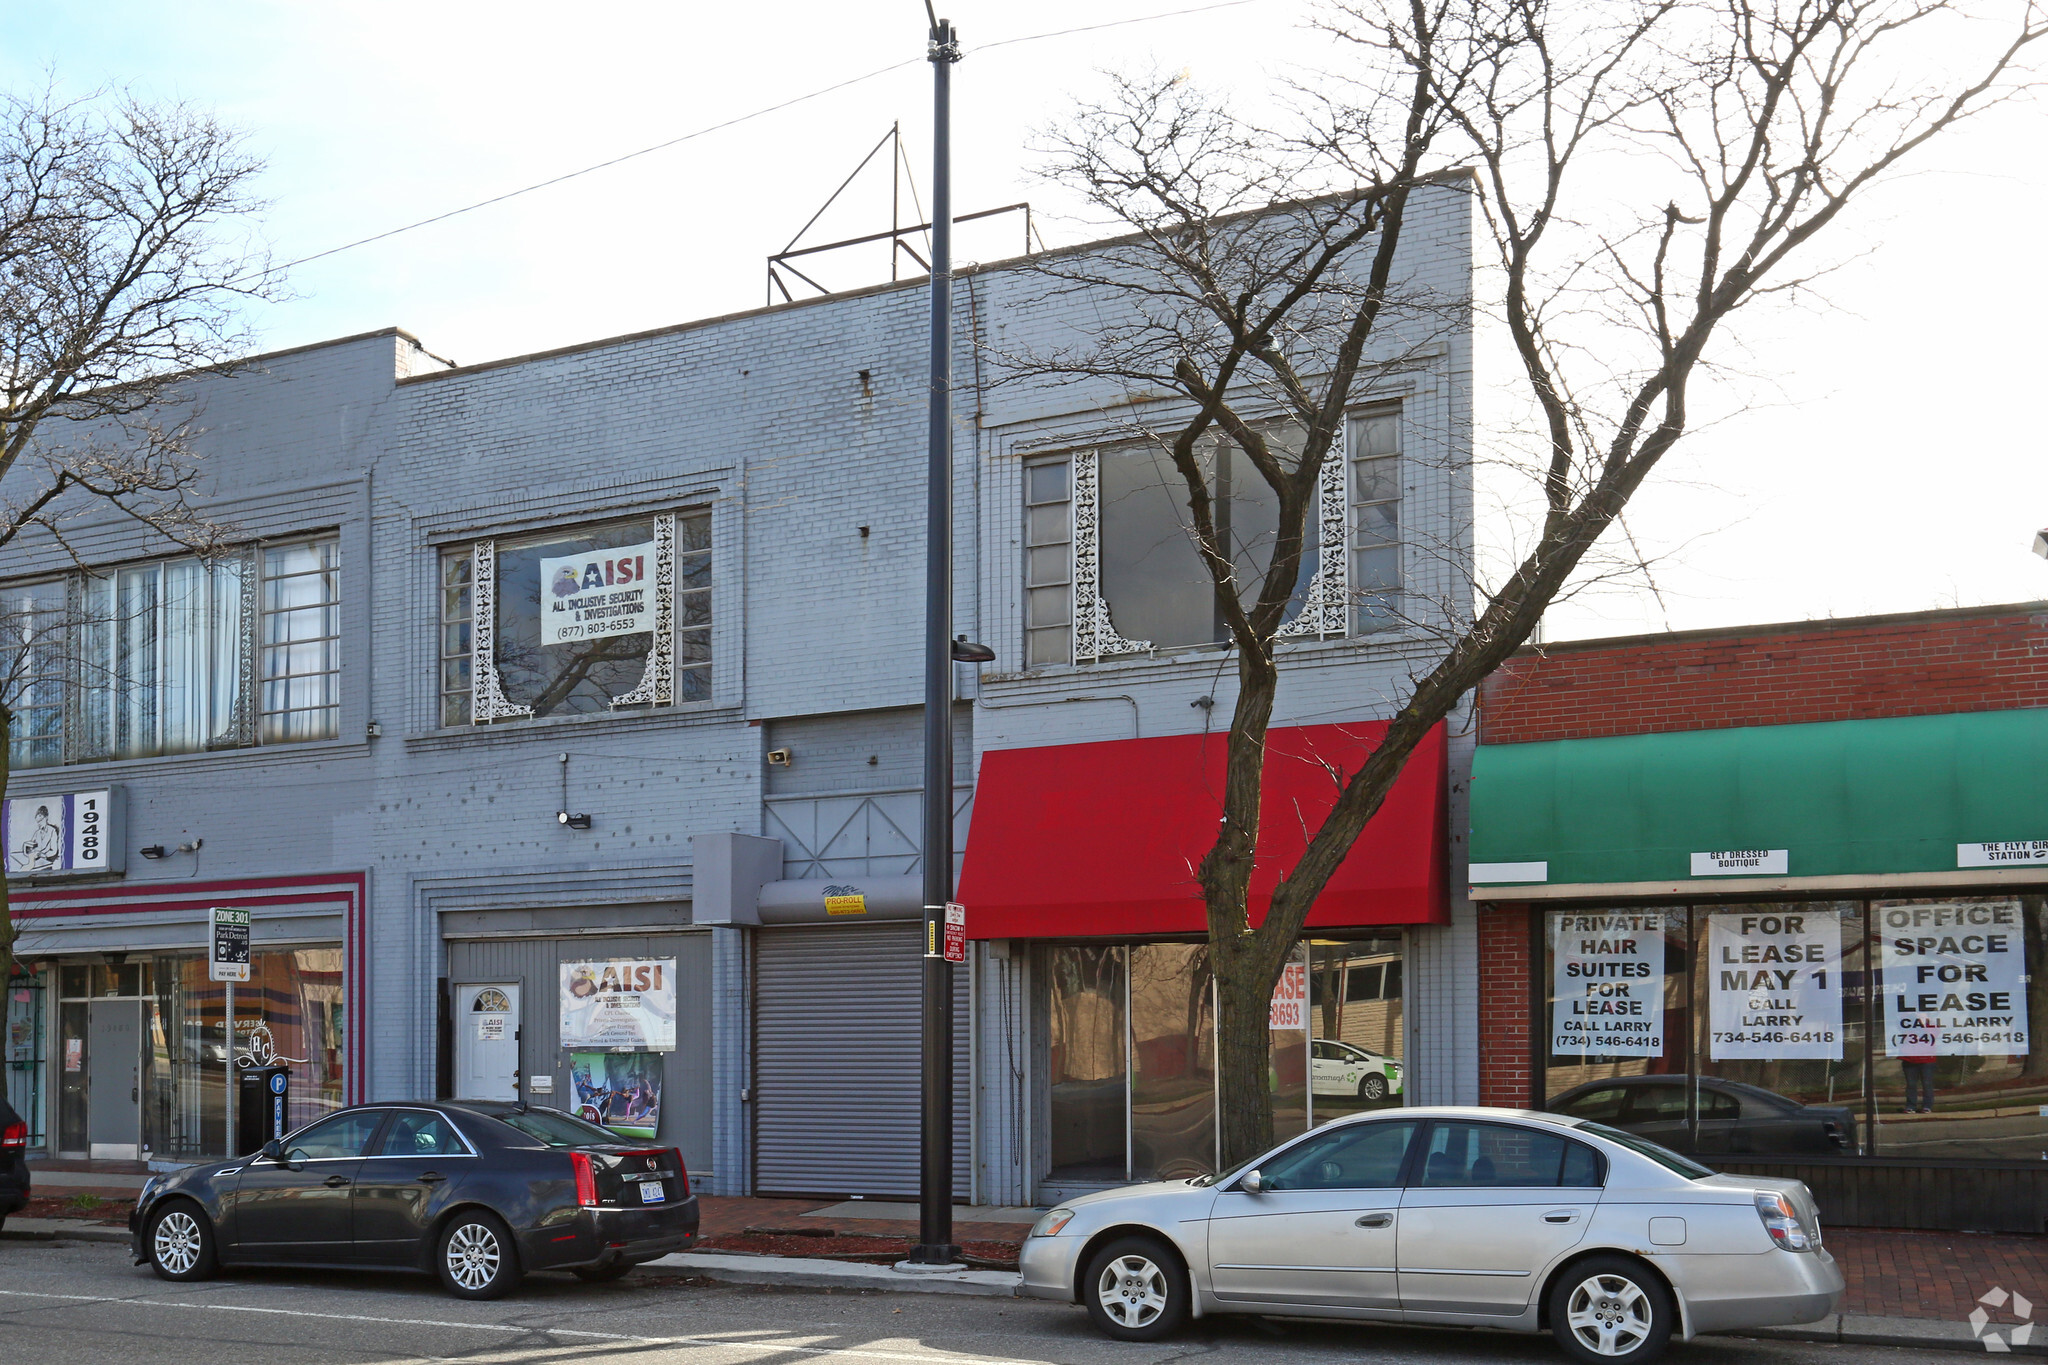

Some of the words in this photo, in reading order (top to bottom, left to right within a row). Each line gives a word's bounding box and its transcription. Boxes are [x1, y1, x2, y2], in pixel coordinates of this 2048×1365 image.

[581, 556, 644, 589] AISI
[552, 601, 565, 612] ALL
[568, 595, 606, 610] INCLUSIVE
[609, 589, 644, 604] SECURITY
[575, 611, 581, 621] &
[584, 602, 644, 620] INVESTIGATIONS
[557, 625, 584, 640] (877)
[588, 618, 635, 634] 803-6553
[82, 799, 99, 860] 19480
[1981, 843, 2000, 851] THE
[2005, 842, 2027, 850] FLYY
[1730, 850, 1769, 859] DRESSED
[1989, 851, 2030, 860] STATION
[1719, 859, 1760, 868] BOUTIQUE
[826, 897, 862, 905] PRO-ROLL
[216, 910, 235, 923] ZONE
[235, 912, 249, 924] 301
[1561, 916, 1658, 931] PRIVATE
[1886, 905, 2015, 928] OFFICE
[1742, 917, 1805, 935] FOR
[1581, 940, 1637, 954] HAIR
[1894, 935, 2008, 956] SPACE
[1722, 944, 1824, 964] LEASE
[1567, 963, 1650, 977] SUITES
[1917, 964, 1989, 984] FOR
[599, 965, 662, 992] AISI
[1272, 966, 1305, 1000] ASE
[1721, 970, 1798, 991] MAY
[1811, 969, 1827, 989] 1
[1586, 983, 1630, 997] FOR
[1573, 1001, 1642, 1015] LEASE
[1749, 999, 1796, 1010] CALL
[1897, 992, 2011, 1013] LEASE
[1564, 1021, 1599, 1031] CALL
[1605, 1022, 1652, 1032] LARRY
[1743, 1015, 1804, 1026] LARRY
[1900, 1018, 1947, 1029] CALL
[1953, 1016, 2014, 1027] LARRY
[1556, 1035, 1591, 1048] (734)
[1596, 1036, 1660, 1047] 546-6418
[1713, 1032, 1834, 1043] 734-546-6418
[1892, 1034, 1935, 1046] (734)
[1942, 1032, 2024, 1044] 546-6418
[276, 1080, 283, 1091] P
